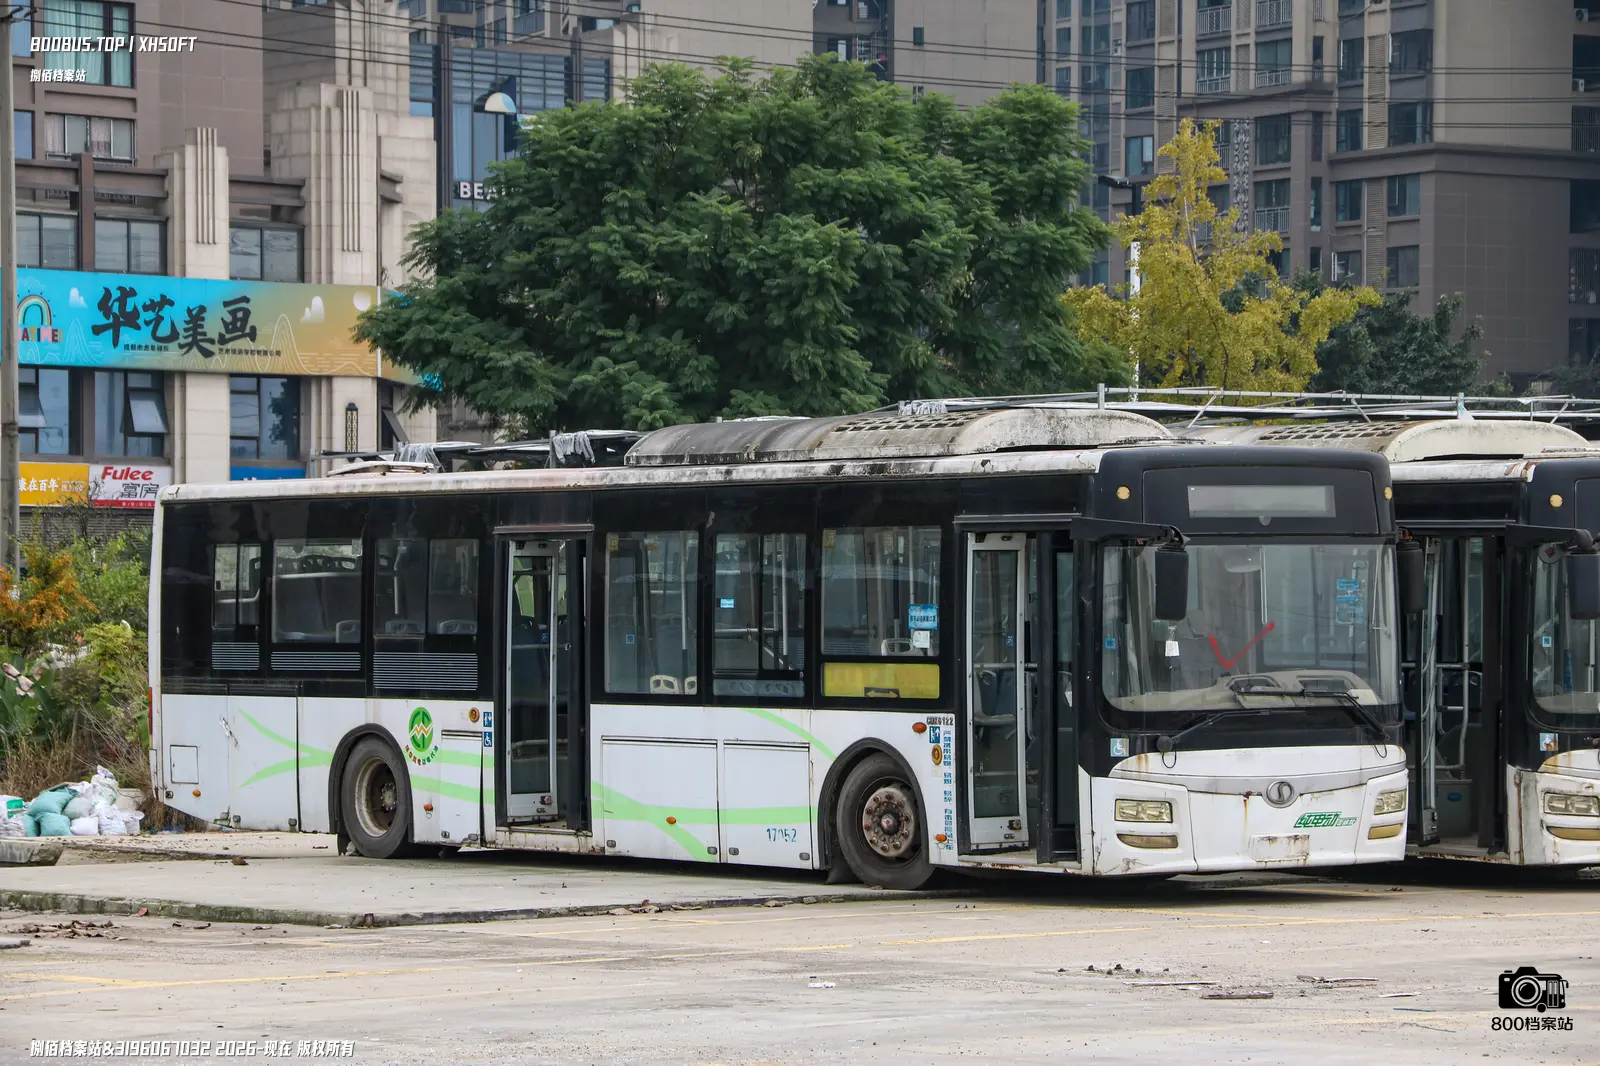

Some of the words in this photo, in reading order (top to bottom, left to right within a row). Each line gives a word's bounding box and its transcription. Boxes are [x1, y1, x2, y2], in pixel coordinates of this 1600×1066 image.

[91, 286, 257, 359] 华艺美画
[101, 466, 154, 480] Fulee
